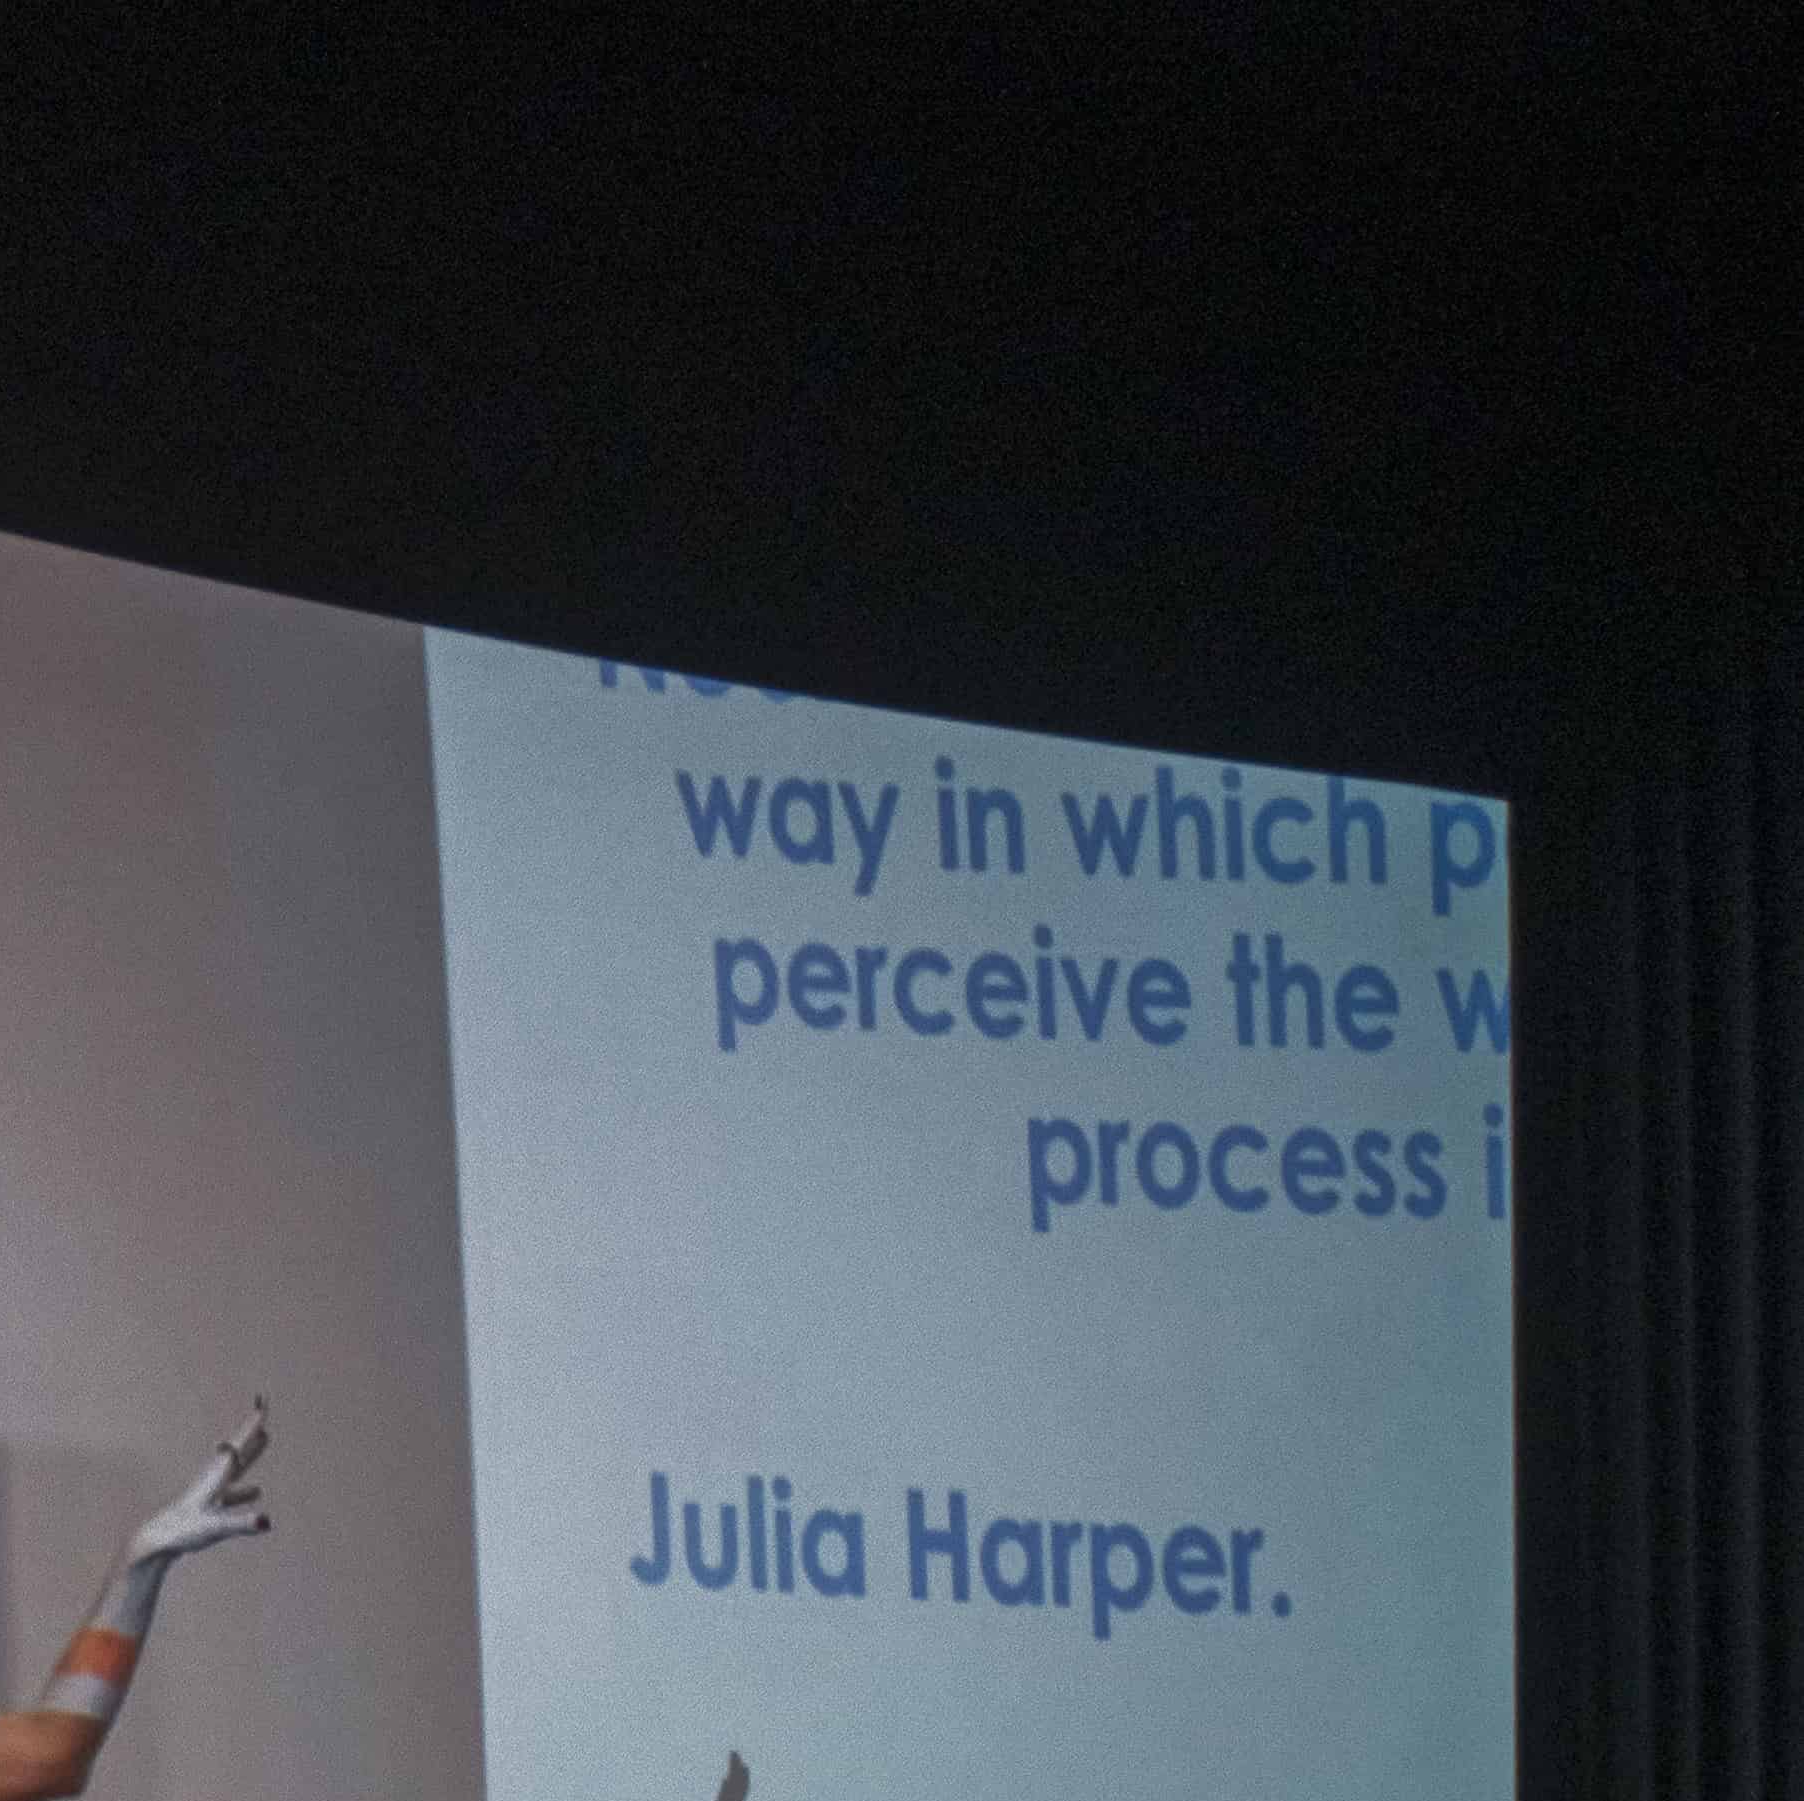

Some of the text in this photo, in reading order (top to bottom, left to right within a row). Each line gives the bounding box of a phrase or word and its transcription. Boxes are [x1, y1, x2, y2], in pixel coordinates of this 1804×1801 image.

[675, 767, 899, 896] way
[935, 755, 1025, 875] in
[1060, 764, 1388, 885] which
[713, 922, 1191, 1052] perceive
[1227, 931, 1400, 1052] the
[1027, 1114, 1446, 1232] process
[630, 1470, 1293, 1641] Julia Harper.
